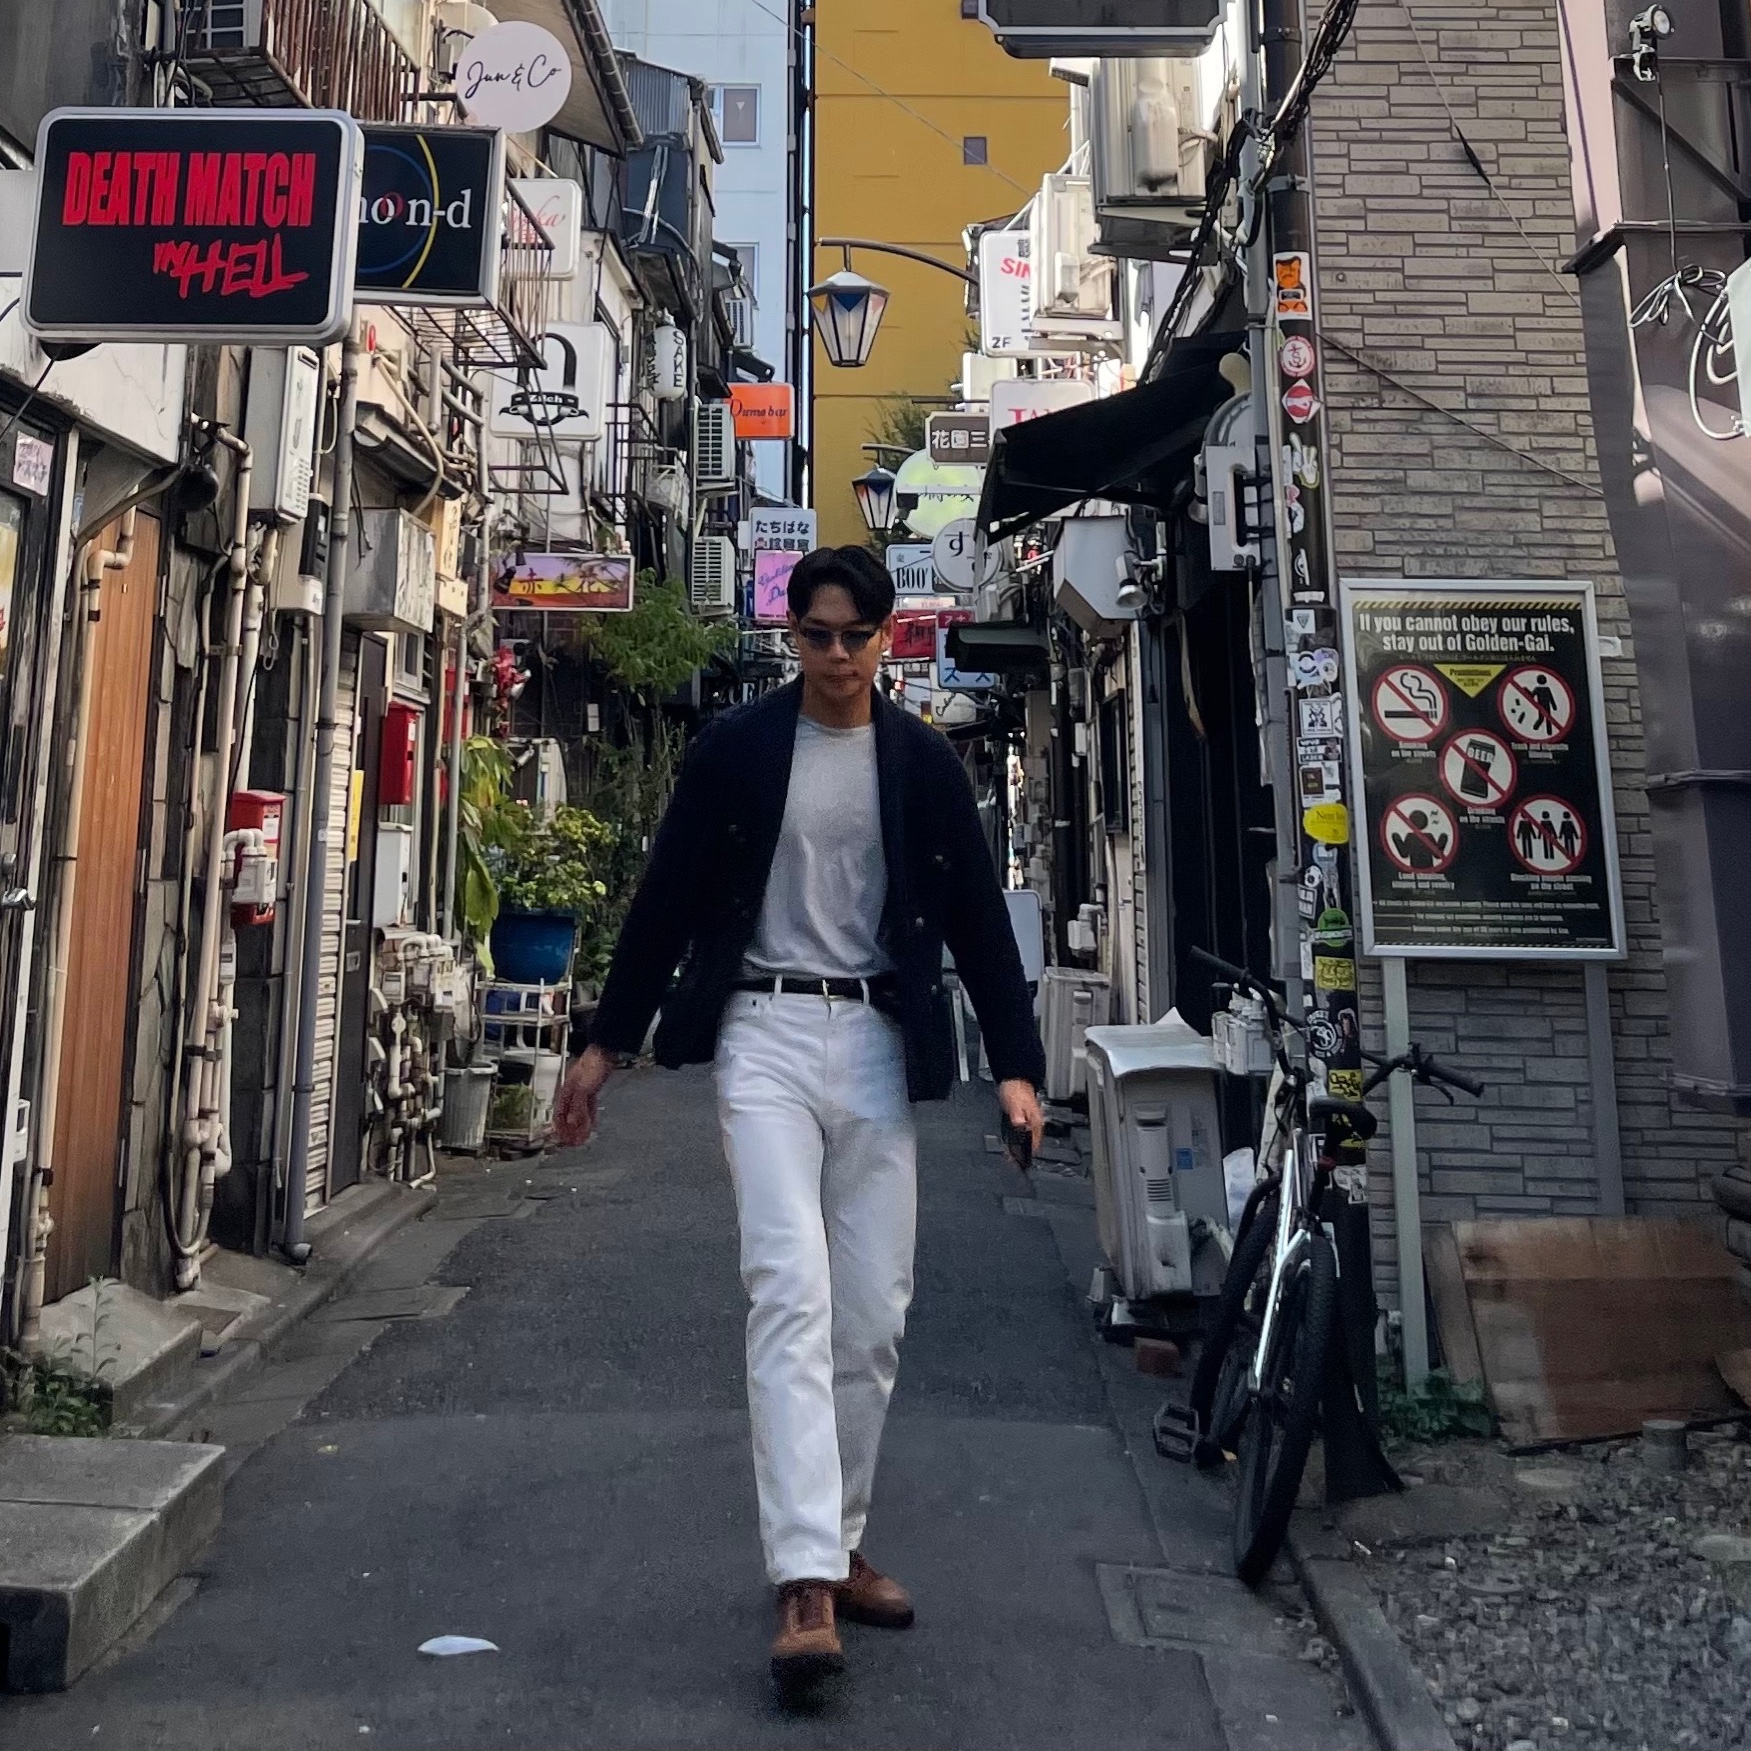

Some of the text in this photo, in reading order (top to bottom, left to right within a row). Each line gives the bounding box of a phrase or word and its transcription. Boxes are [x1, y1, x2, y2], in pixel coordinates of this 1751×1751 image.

[511, 63, 525, 91] &
[528, 54, 562, 88] Co
[63, 152, 317, 227] DEATH MATCH
[153, 233, 310, 300] IN HELL
[992, 336, 1011, 349] 2F
[672, 331, 684, 388] SAKE
[755, 520, 810, 535] たちばな
[1359, 613, 1575, 634] If you cannot obey our rules,
[1382, 634, 1555, 653] stay out of Golden-Gai.
[1467, 747, 1496, 763] BEER
